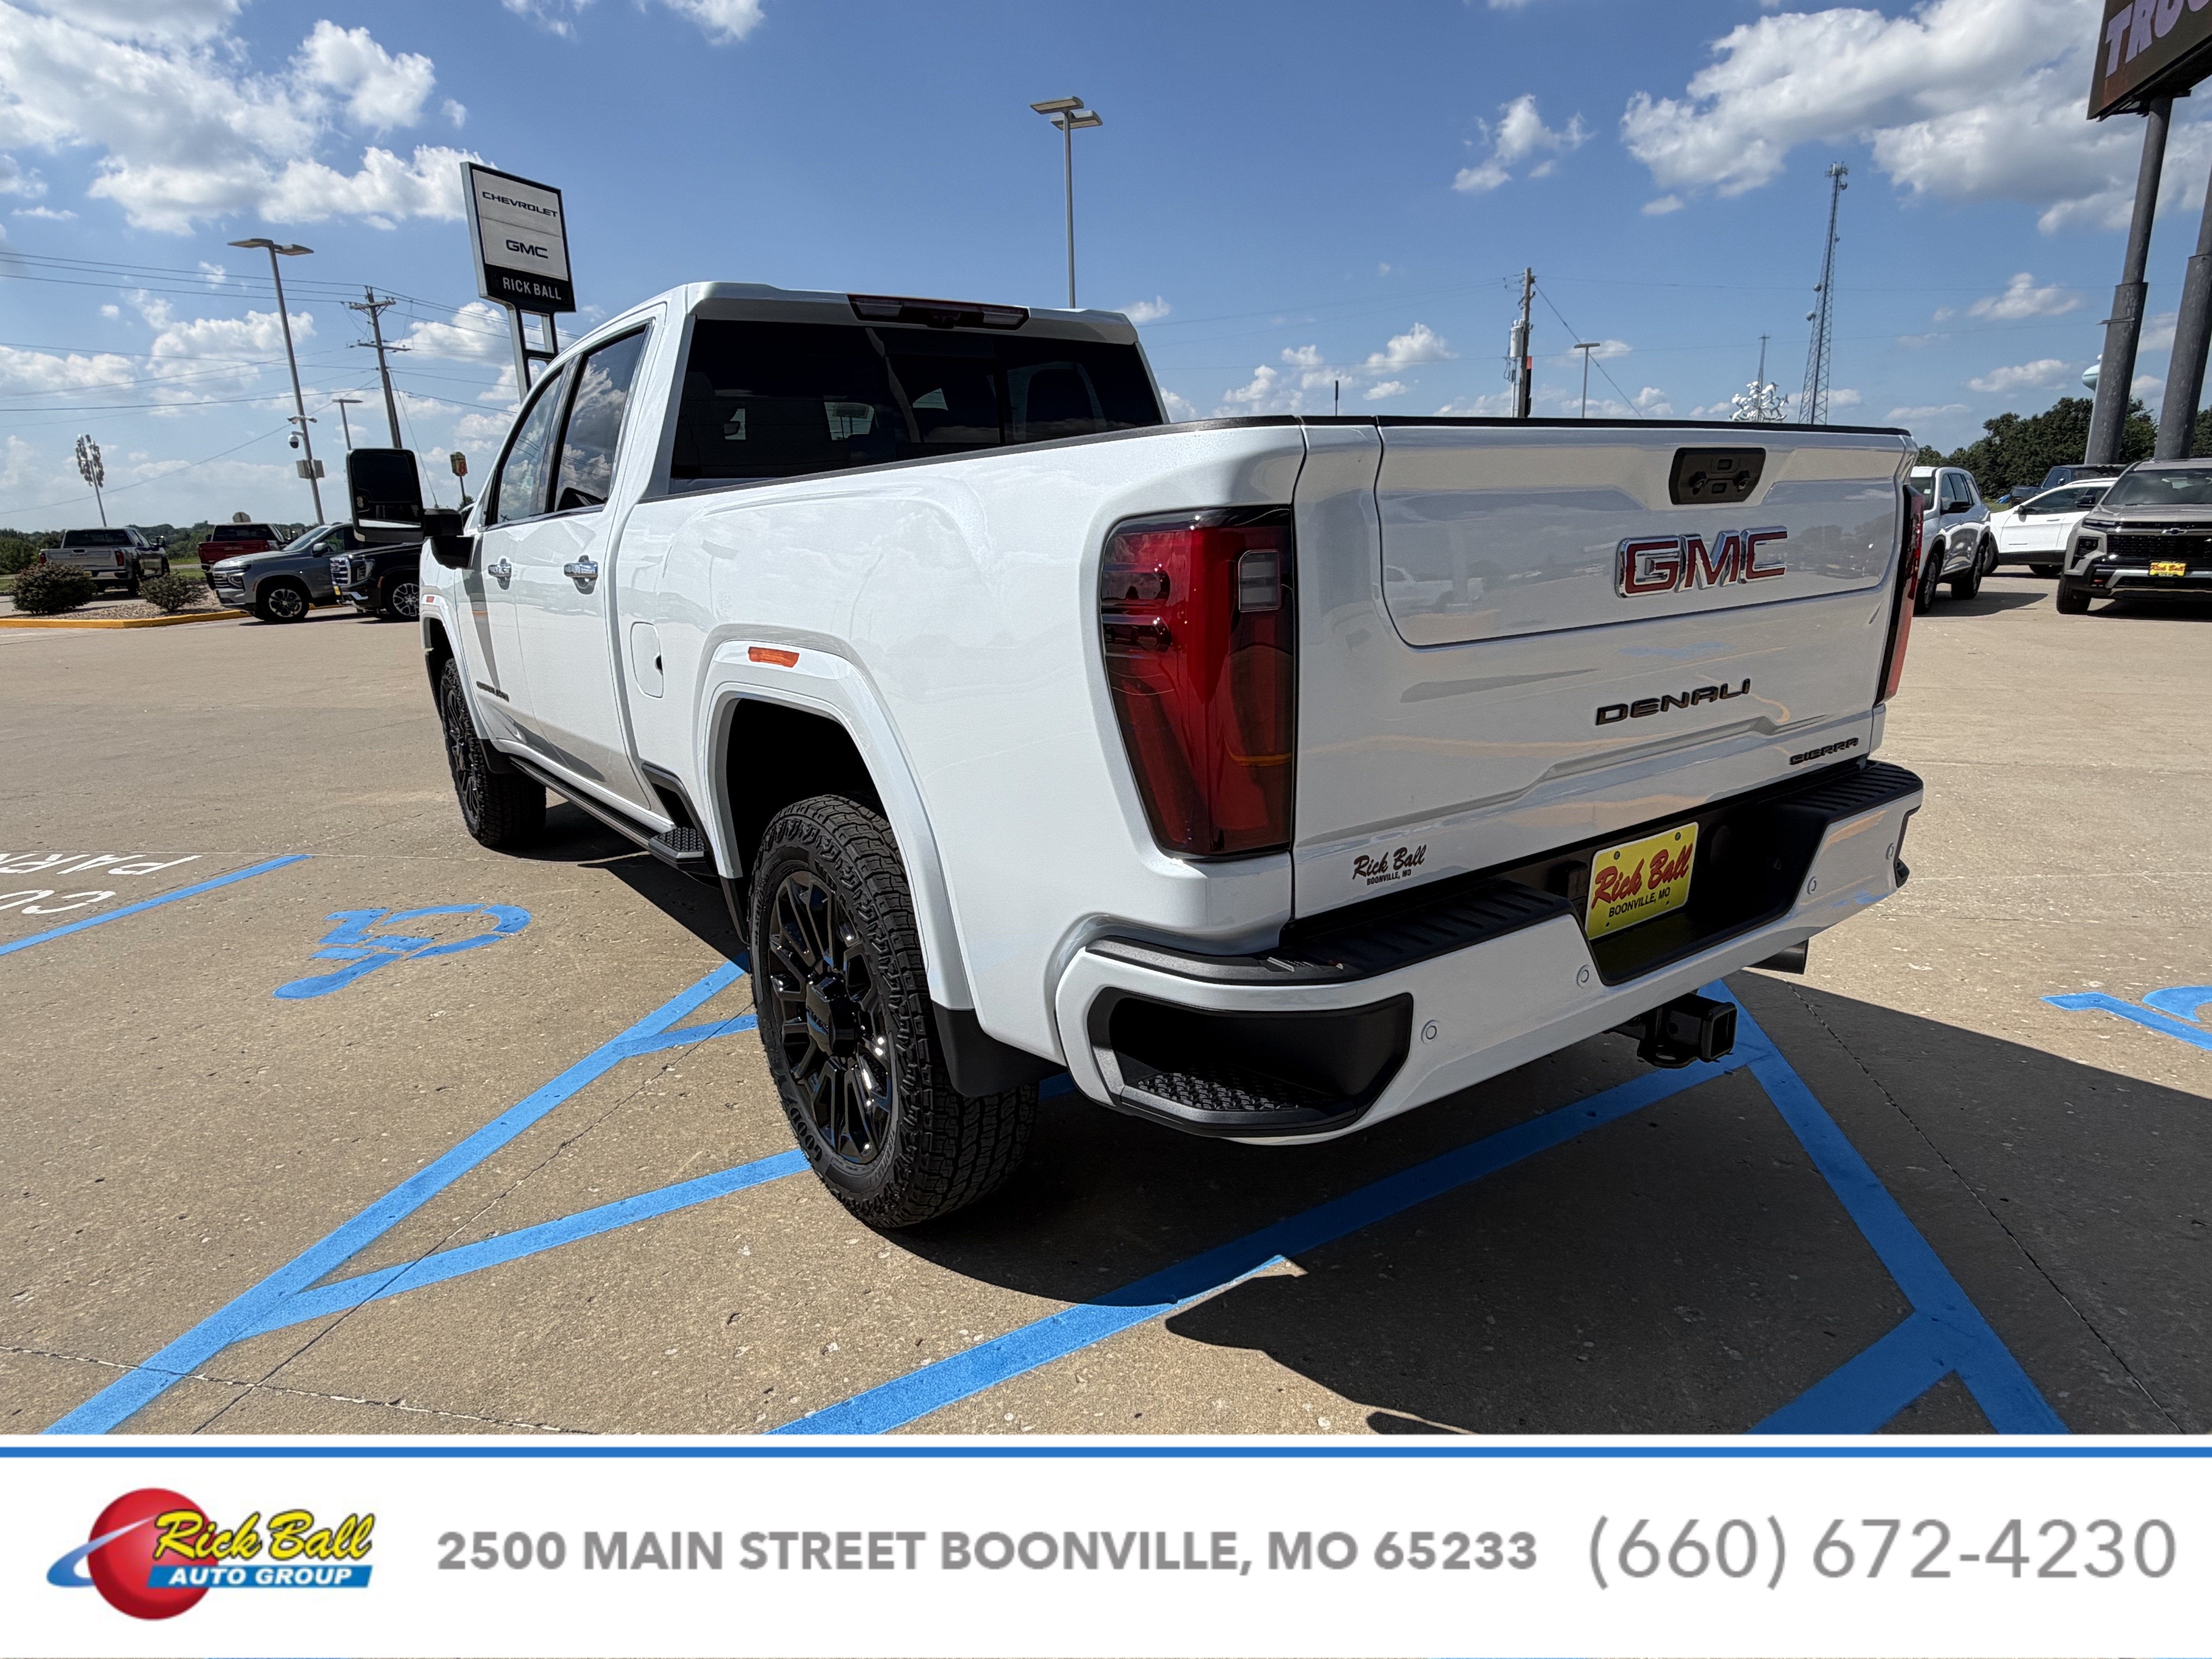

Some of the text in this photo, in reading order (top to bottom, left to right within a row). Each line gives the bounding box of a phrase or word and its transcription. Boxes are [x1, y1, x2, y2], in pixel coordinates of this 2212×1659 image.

[2106, 0, 2208, 78] TRU
[482, 191, 558, 217] CHEVROLET
[506, 239, 548, 259] GMC
[503, 277, 562, 300] RICK BALL
[1615, 525, 1788, 599] GMC
[1595, 678, 1751, 726] DENALI
[1789, 737, 1859, 765] SIERRA
[1352, 844, 1427, 879] Rick Ball
[1367, 869, 1412, 885] BOONVILLE, MO
[1591, 843, 1693, 910] Rick Ball
[1608, 887, 1671, 918] BOONVILLE, MO
